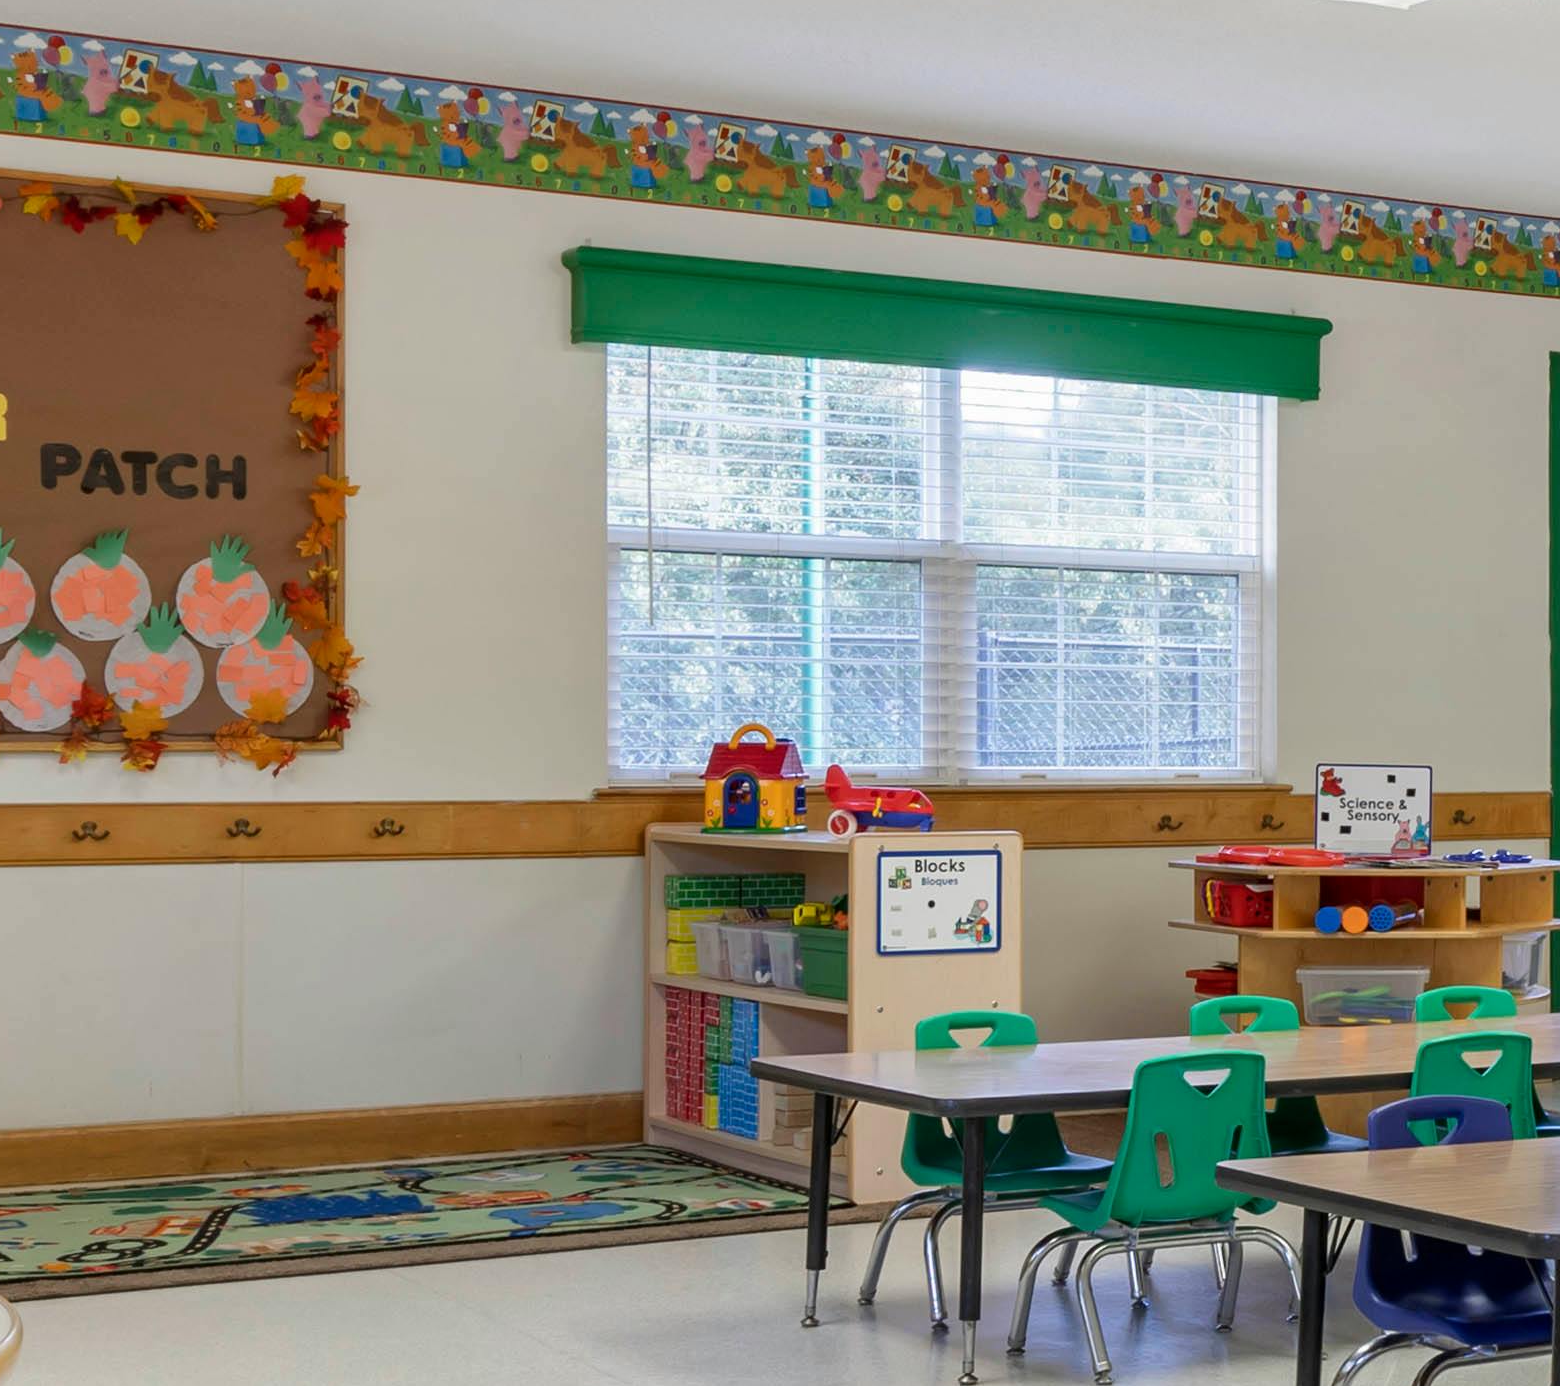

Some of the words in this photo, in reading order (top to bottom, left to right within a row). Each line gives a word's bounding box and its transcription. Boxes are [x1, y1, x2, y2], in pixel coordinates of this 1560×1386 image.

[14, 120, 18, 130] 1
[35, 123, 42, 133] 2
[104, 130, 110, 140] 5
[147, 134, 155, 146] 7
[213, 142, 220, 151] 0
[234, 145, 238, 155] 1
[255, 147, 261, 157] 2
[317, 153, 324, 163] 5
[359, 157, 366, 168] 7
[419, 164, 425, 173] 0
[40, 443, 247, 500] PATCH
[1340, 797, 1394, 809] Science
[1399, 799, 1408, 810] &
[1347, 809, 1400, 824] Sensory
[914, 859, 966, 873] Blocks
[921, 877, 959, 887] Bloques
